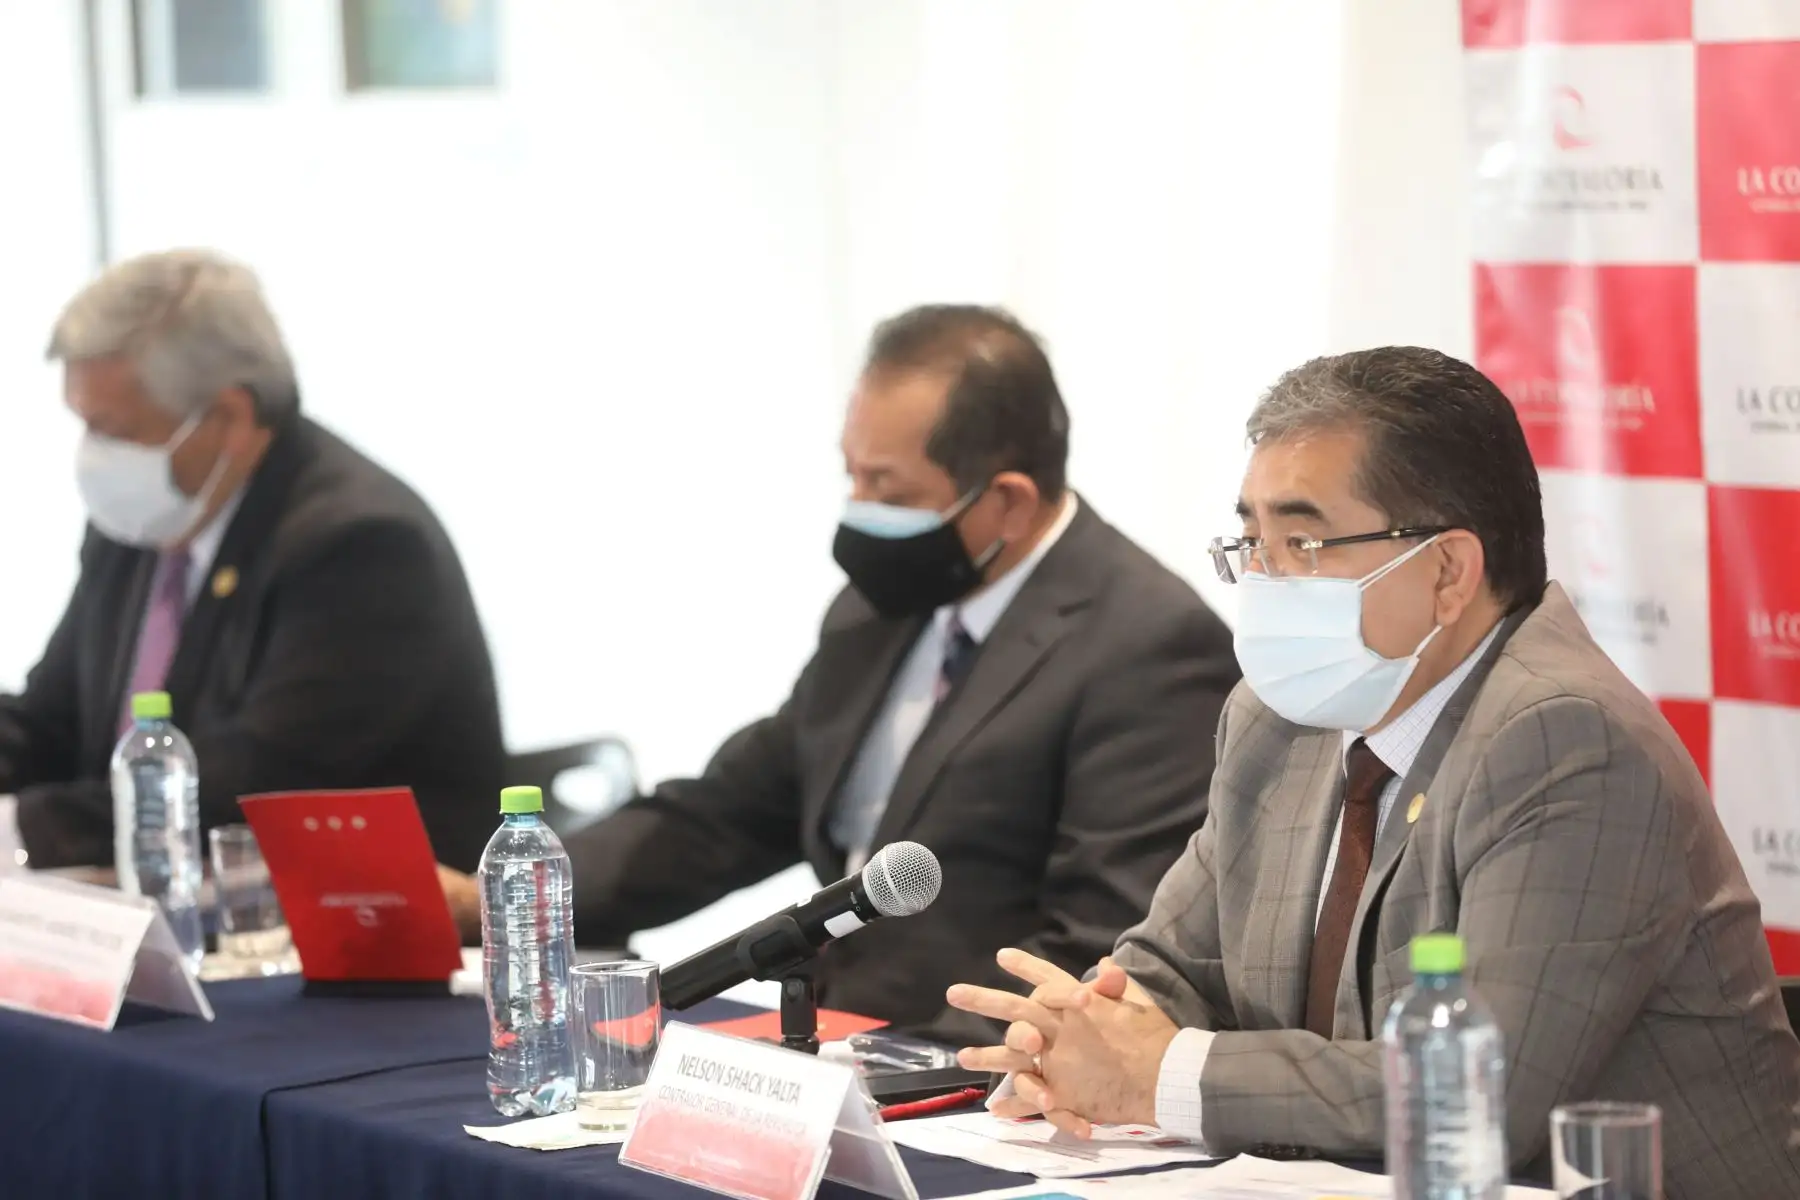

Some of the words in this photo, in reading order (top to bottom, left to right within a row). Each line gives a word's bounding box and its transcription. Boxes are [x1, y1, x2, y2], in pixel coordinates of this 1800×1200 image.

[1737, 166, 1765, 196] LA
[1736, 387, 1763, 415] LA
[676, 1053, 725, 1083] NELSON
[724, 1066, 766, 1094] SHACK
[767, 1076, 802, 1105] YALTA
